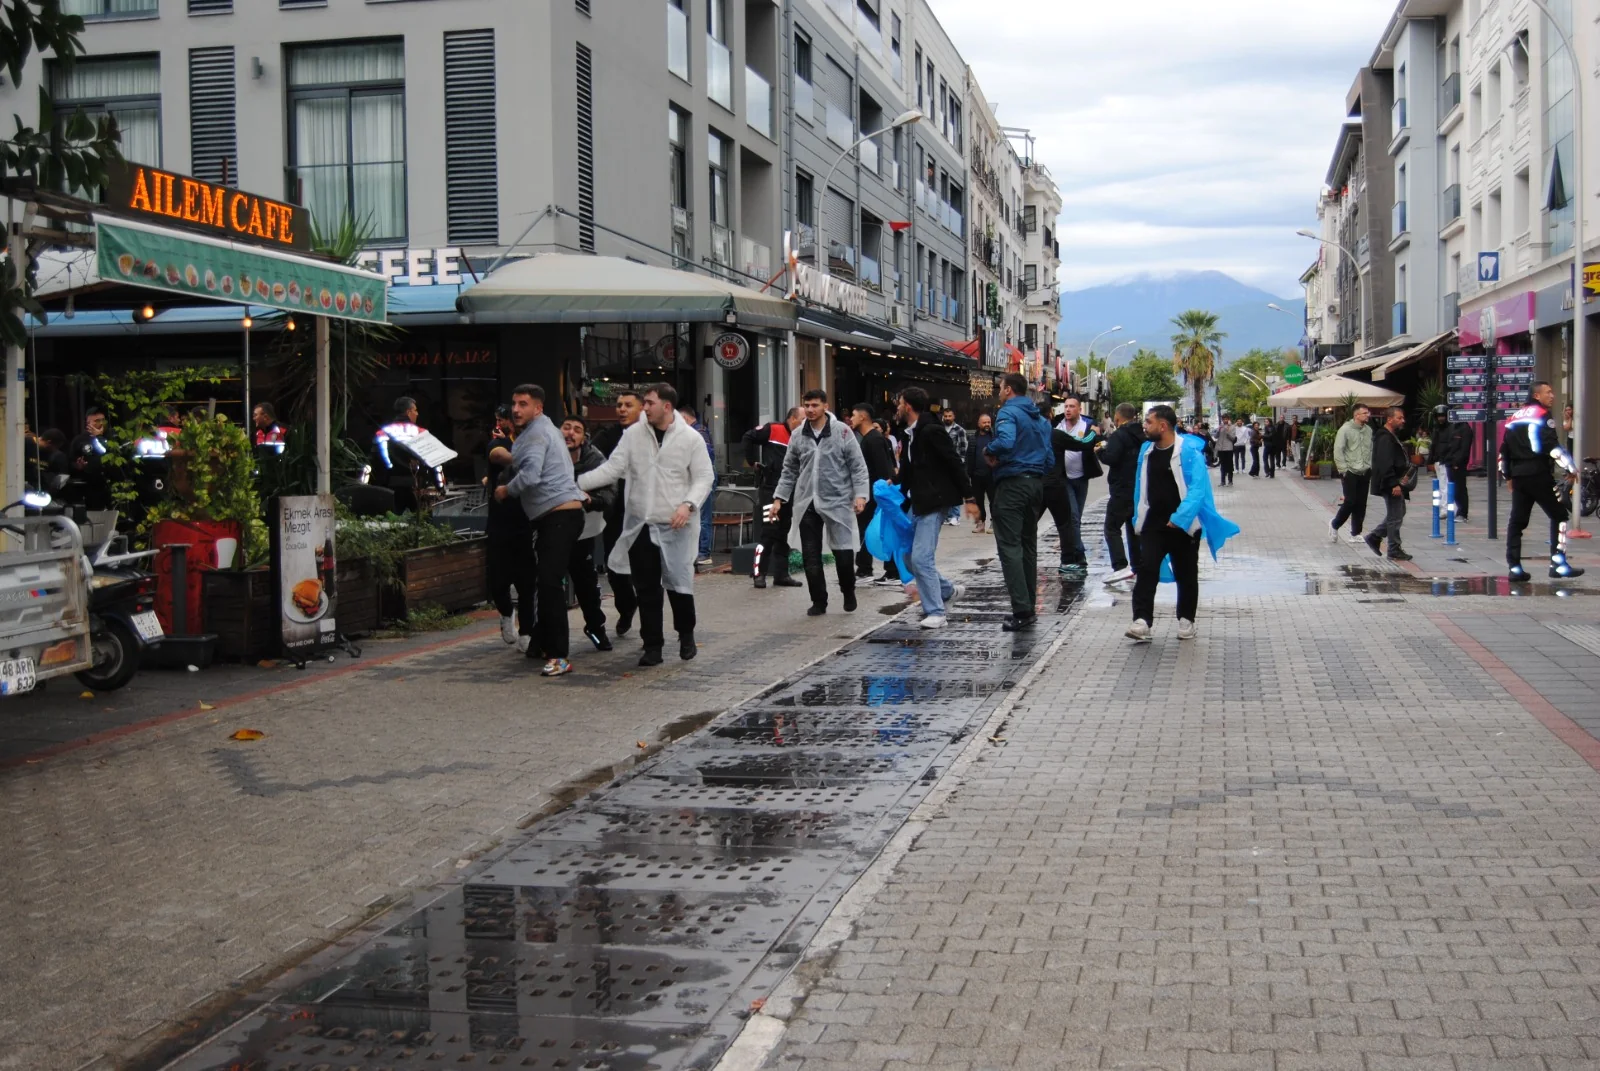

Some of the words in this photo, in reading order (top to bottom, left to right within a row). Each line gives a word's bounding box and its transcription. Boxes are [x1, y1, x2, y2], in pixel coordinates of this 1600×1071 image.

[229, 192, 294, 244] CAFE
[717, 336, 734, 347] MADE
[284, 508, 312, 520] Ekmek
[314, 507, 333, 518] Arası
[284, 521, 311, 535] Mezgit
[2, 664, 13, 676] 48
